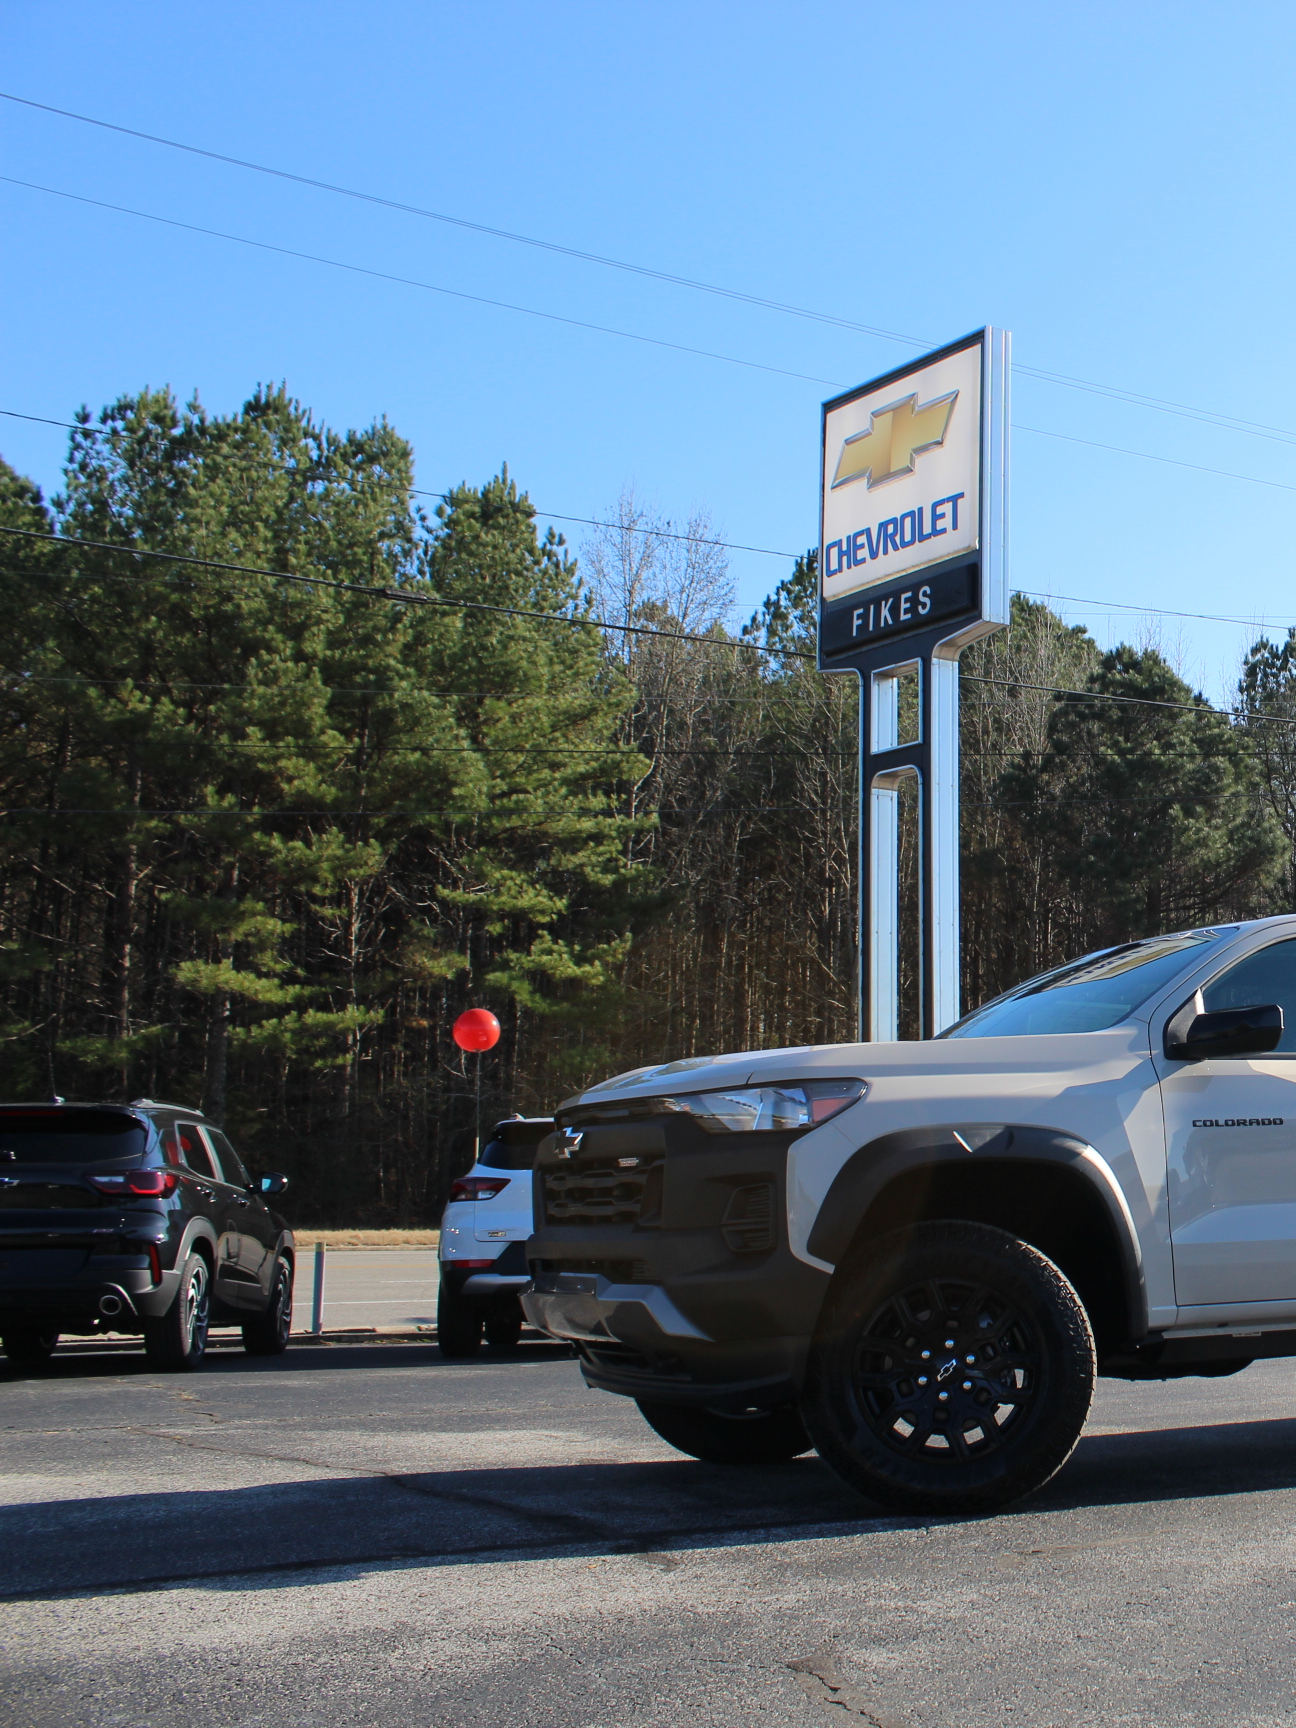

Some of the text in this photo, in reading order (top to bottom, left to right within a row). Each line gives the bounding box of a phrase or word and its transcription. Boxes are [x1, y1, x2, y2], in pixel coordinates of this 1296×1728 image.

[825, 492, 964, 578] CHEVROLET
[852, 585, 931, 637] FIKES
[1192, 1117, 1284, 1128] COLORADO
